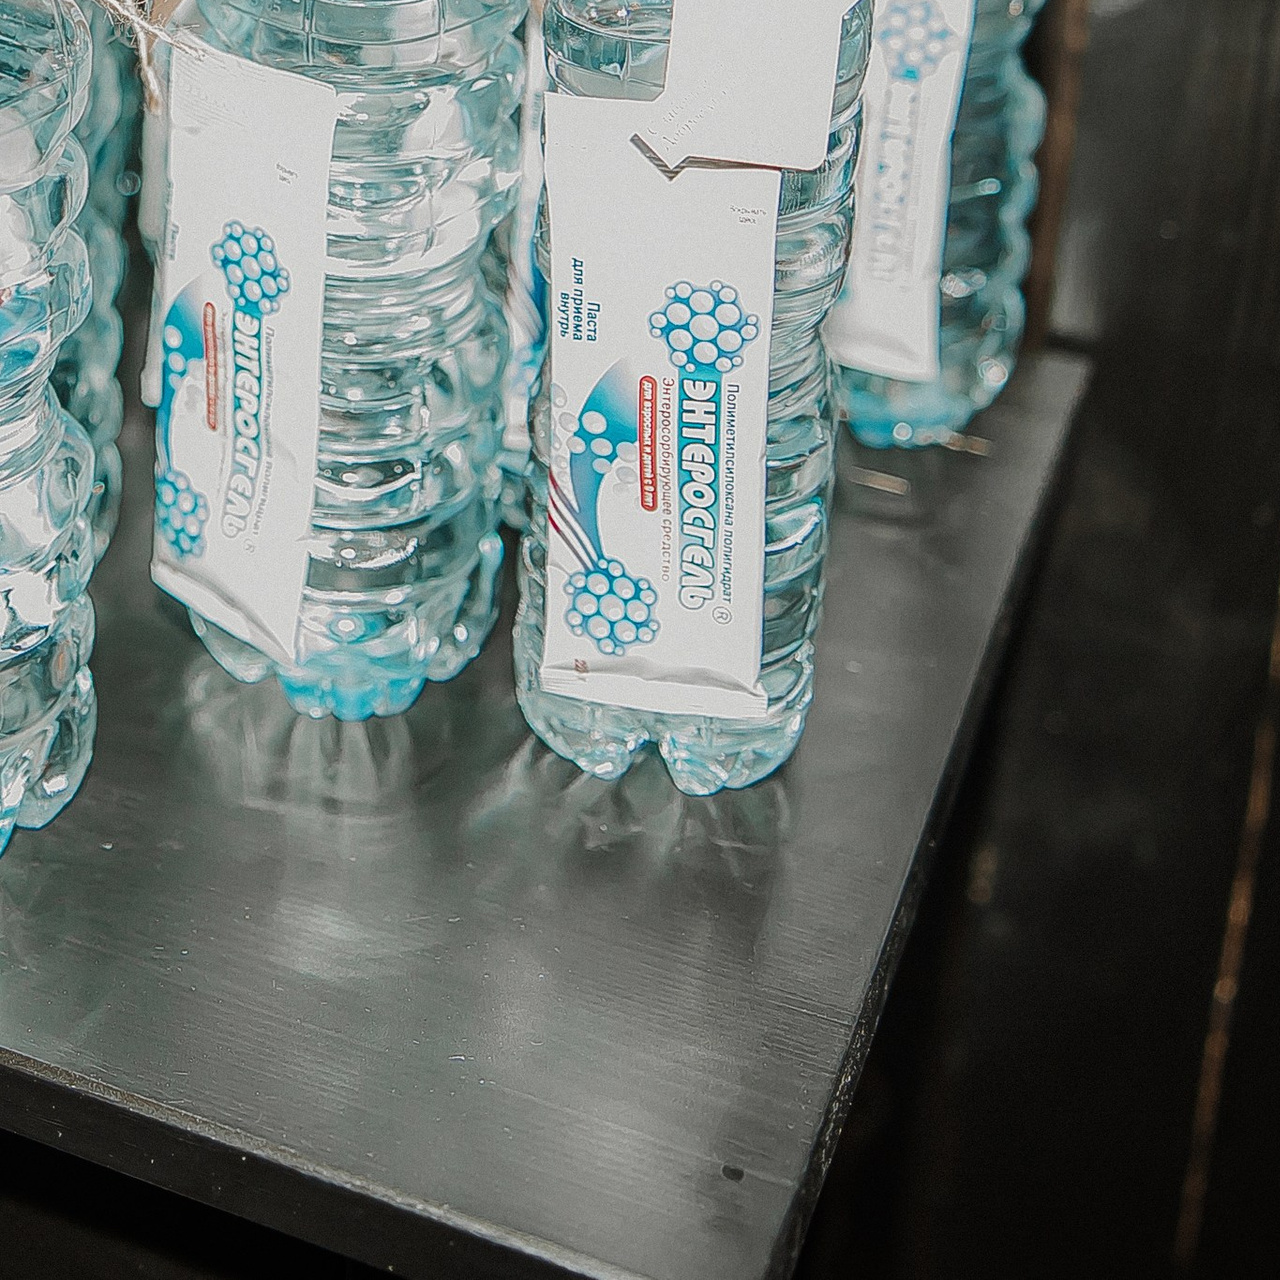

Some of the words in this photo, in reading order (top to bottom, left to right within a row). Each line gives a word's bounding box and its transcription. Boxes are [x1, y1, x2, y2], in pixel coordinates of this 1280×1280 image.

[572, 257, 583, 285] для
[557, 292, 570, 337] внутрь
[570, 288, 583, 340] приема
[587, 302, 600, 342] Паста
[643, 381, 653, 399] для
[220, 310, 261, 539] ЭНТЕРОСГЕЛЬ
[642, 401, 654, 445] взрослых
[659, 377, 674, 515] Энтеросорбирующее
[724, 384, 740, 526] Полиметилсилоксана
[679, 379, 717, 610] ЭНТЕРОСГЕЛЬ
[660, 519, 672, 582] средство
[721, 529, 735, 604] полигидрат
